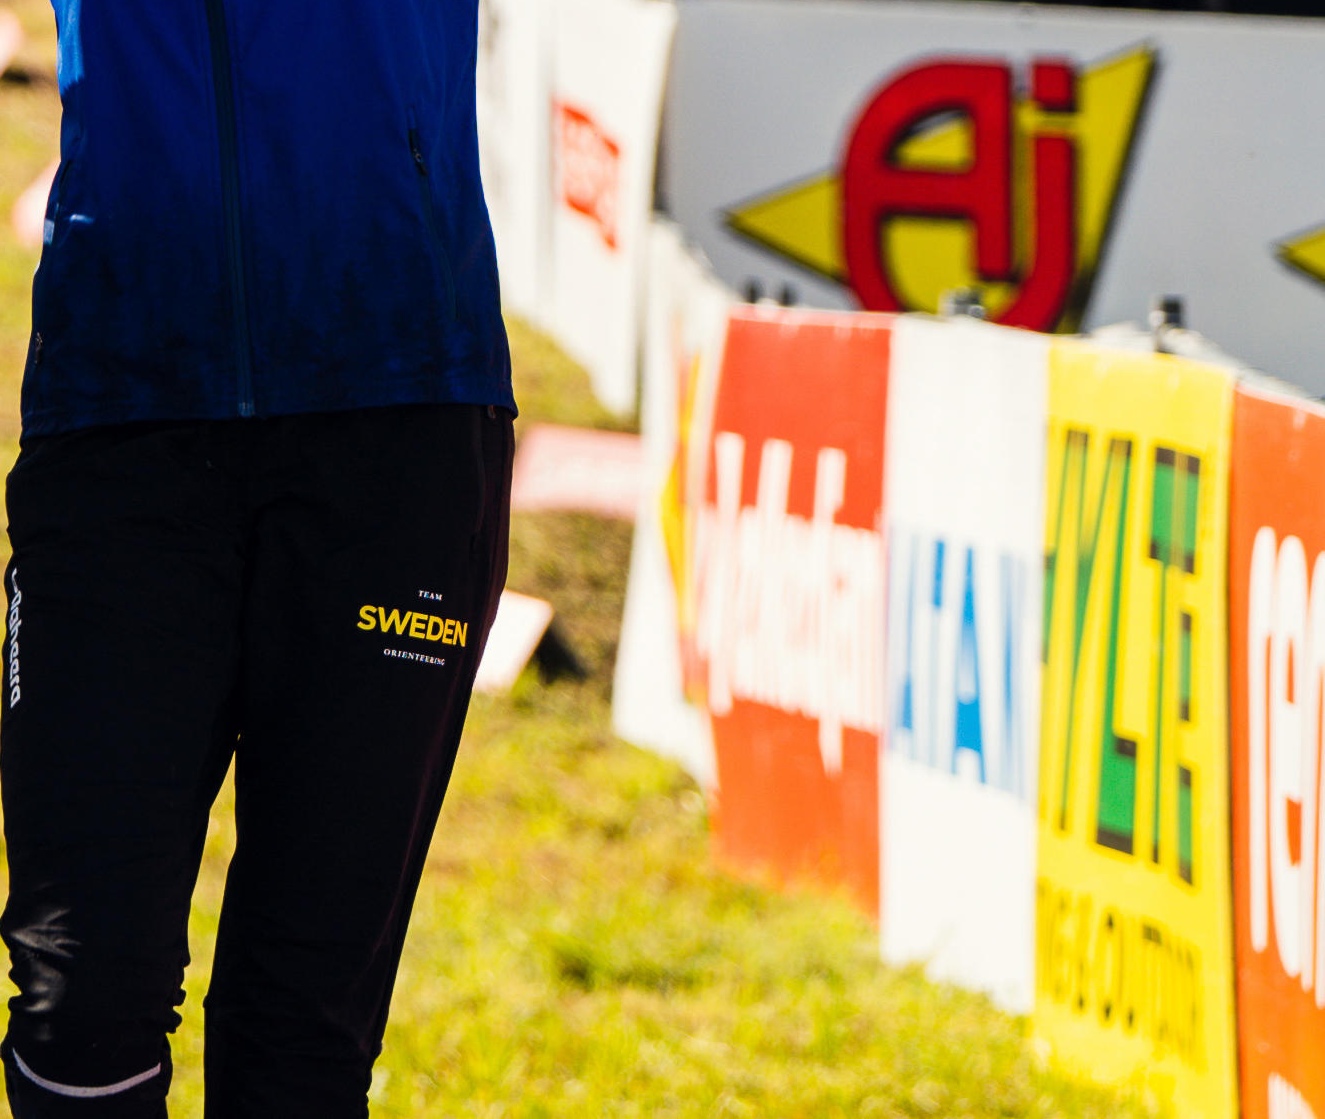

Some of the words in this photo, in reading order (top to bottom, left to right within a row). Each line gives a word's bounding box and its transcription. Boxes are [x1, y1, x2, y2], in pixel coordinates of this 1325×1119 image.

[418, 589, 443, 601] TEAM
[357, 604, 469, 647] SWEDEN
[383, 648, 446, 666] ORIENTEERING
